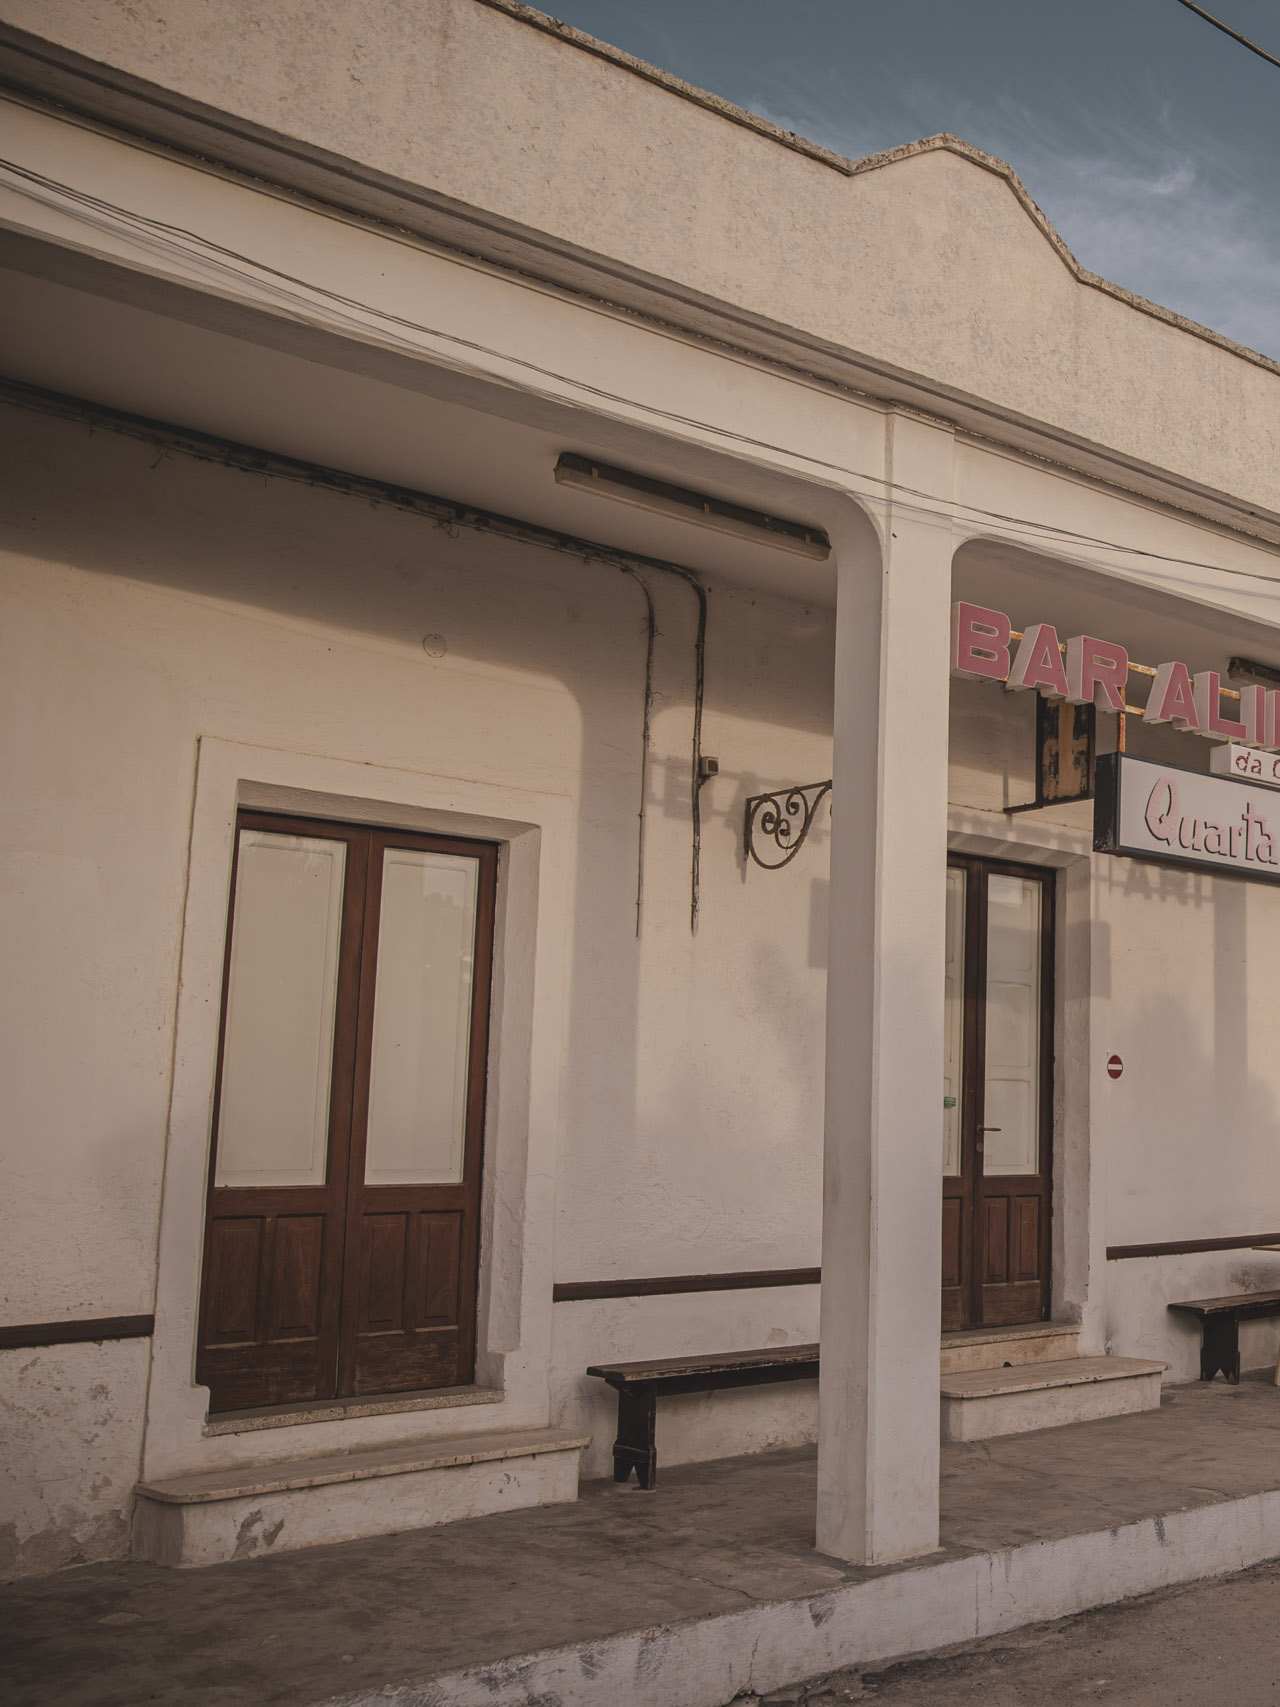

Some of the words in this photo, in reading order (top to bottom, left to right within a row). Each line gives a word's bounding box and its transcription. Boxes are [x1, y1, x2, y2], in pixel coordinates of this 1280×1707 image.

[953, 601, 1128, 711] BAR
[1235, 751, 1262, 775] da
[1144, 777, 1279, 865] Quarta
